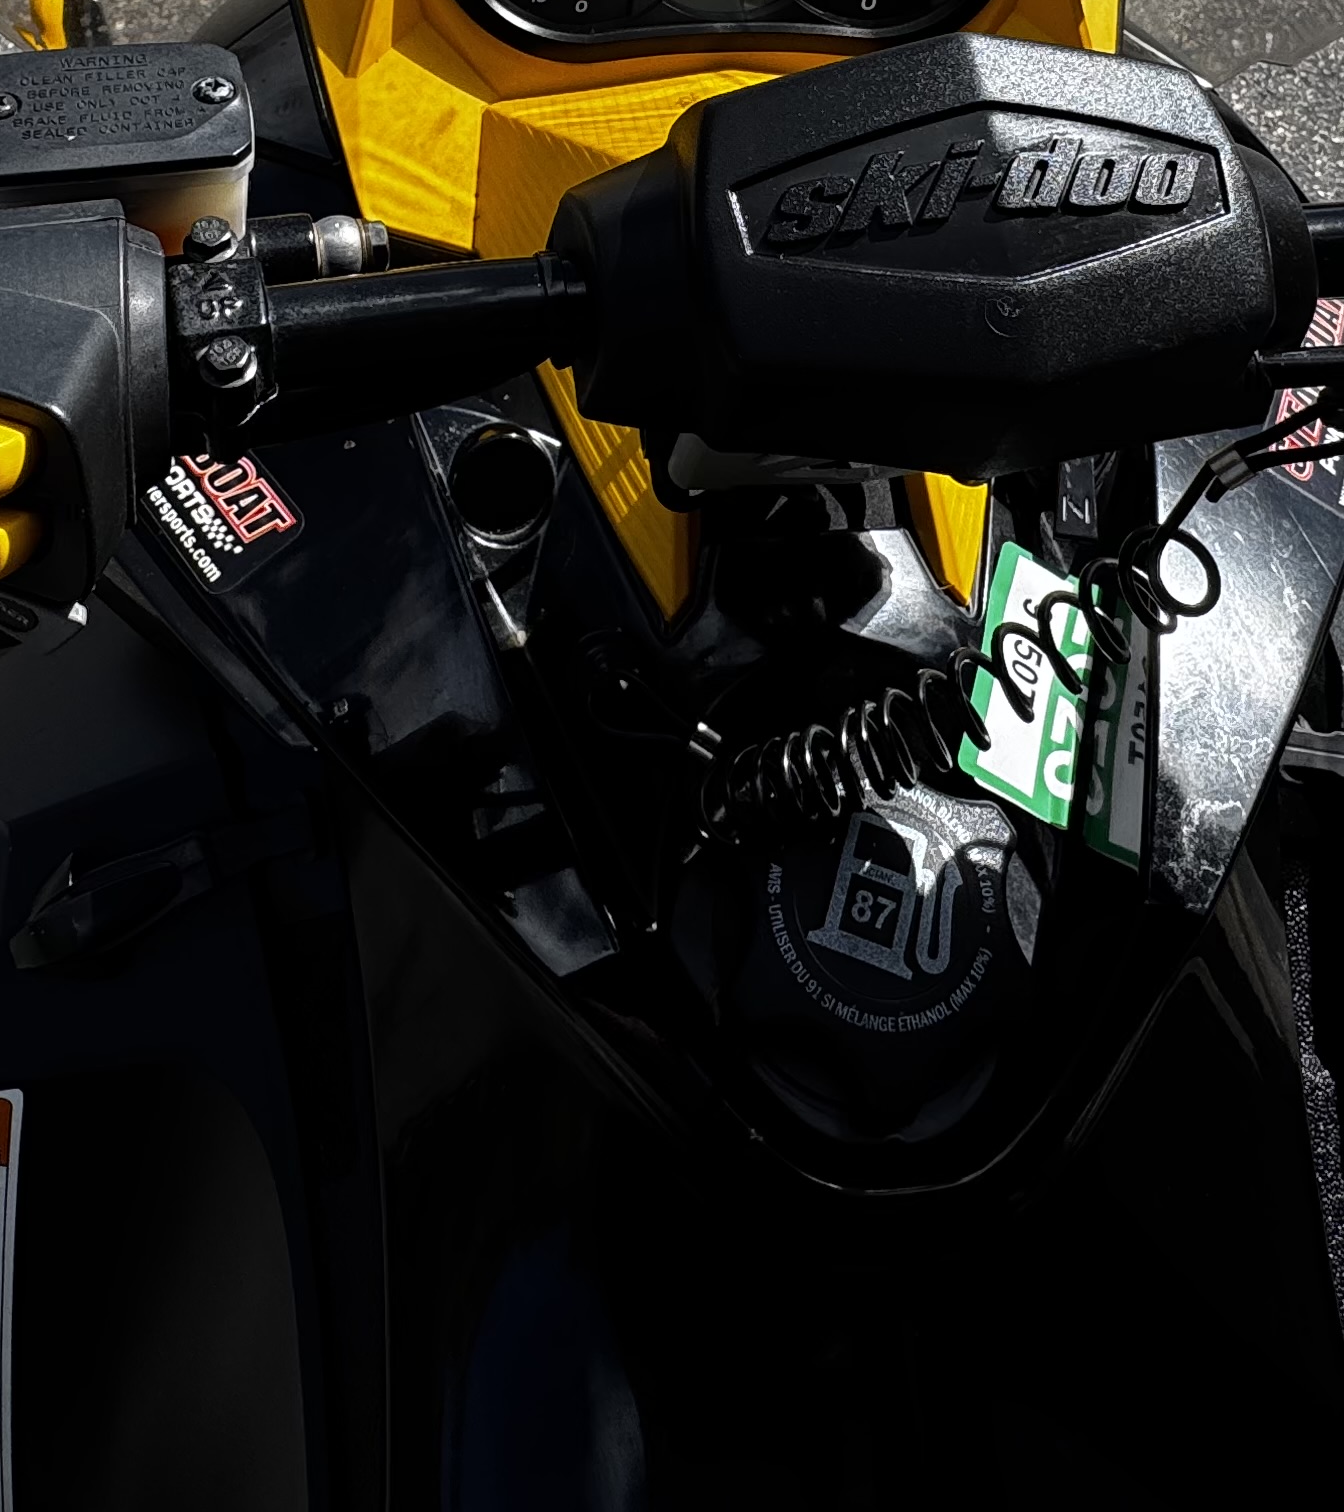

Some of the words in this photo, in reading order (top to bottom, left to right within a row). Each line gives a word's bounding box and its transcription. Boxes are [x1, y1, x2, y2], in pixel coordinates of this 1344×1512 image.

[574, 0, 588, 12] 0
[61, 54, 148, 69] WARNING
[20, 76, 73, 86] CLEAN
[85, 70, 146, 81] FILLER
[157, 67, 186, 78] CAP
[27, 87, 90, 99] BEFORE
[102, 80, 184, 94] REMOVING
[33, 102, 64, 112] USE
[77, 100, 116, 109] ONLY
[130, 96, 161, 106] DOT
[13, 116, 67, 127] BRAKE
[79, 111, 133, 122] FLUID
[144, 107, 184, 117] FROM
[22, 127, 88, 139] SEALED
[99, 119, 194, 134] CONTAINER
[767, 862, 783, 895] AVIS
[980, 879, 997, 914] 10%)
[851, 889, 897, 930] 87
[768, 903, 797, 965] UTILISER
[790, 960, 808, 985] DU
[970, 946, 993, 982] 10%)
[805, 978, 824, 1000] 91
[949, 978, 977, 1013] (MAX
[821, 993, 837, 1012] SI
